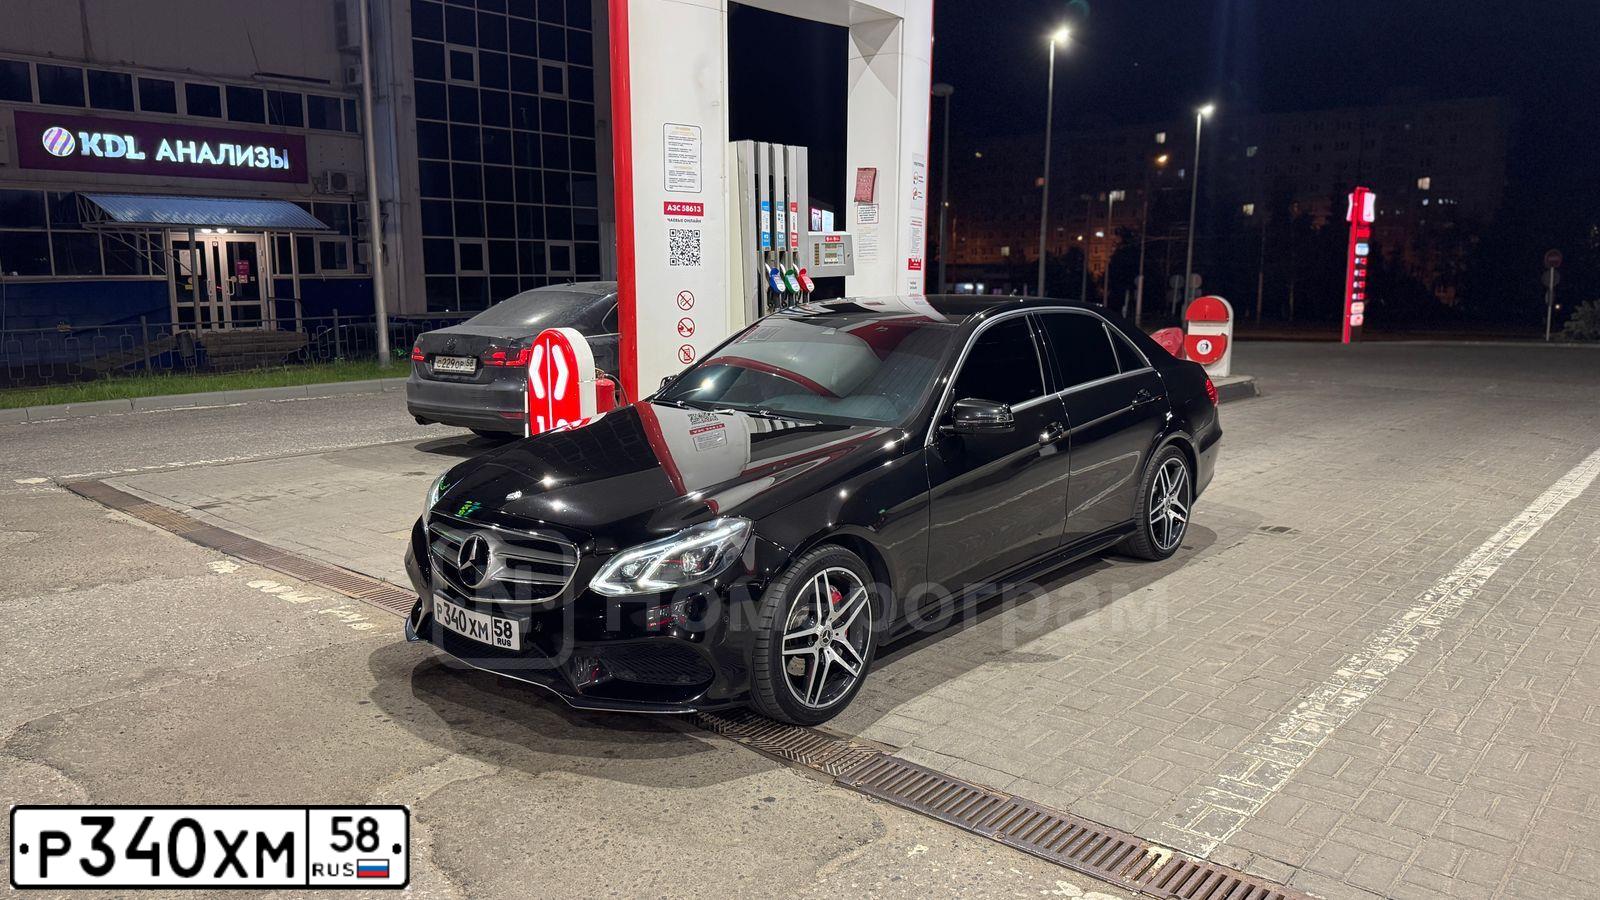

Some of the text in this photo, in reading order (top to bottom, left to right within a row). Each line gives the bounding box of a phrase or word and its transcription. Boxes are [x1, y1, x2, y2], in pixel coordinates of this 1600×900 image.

[78, 131, 146, 161] KDL
[155, 137, 290, 170] АНАЛИЗЫ
[436, 602, 513, 641] Р340ХМ 58
[496, 637, 512, 647] RUS
